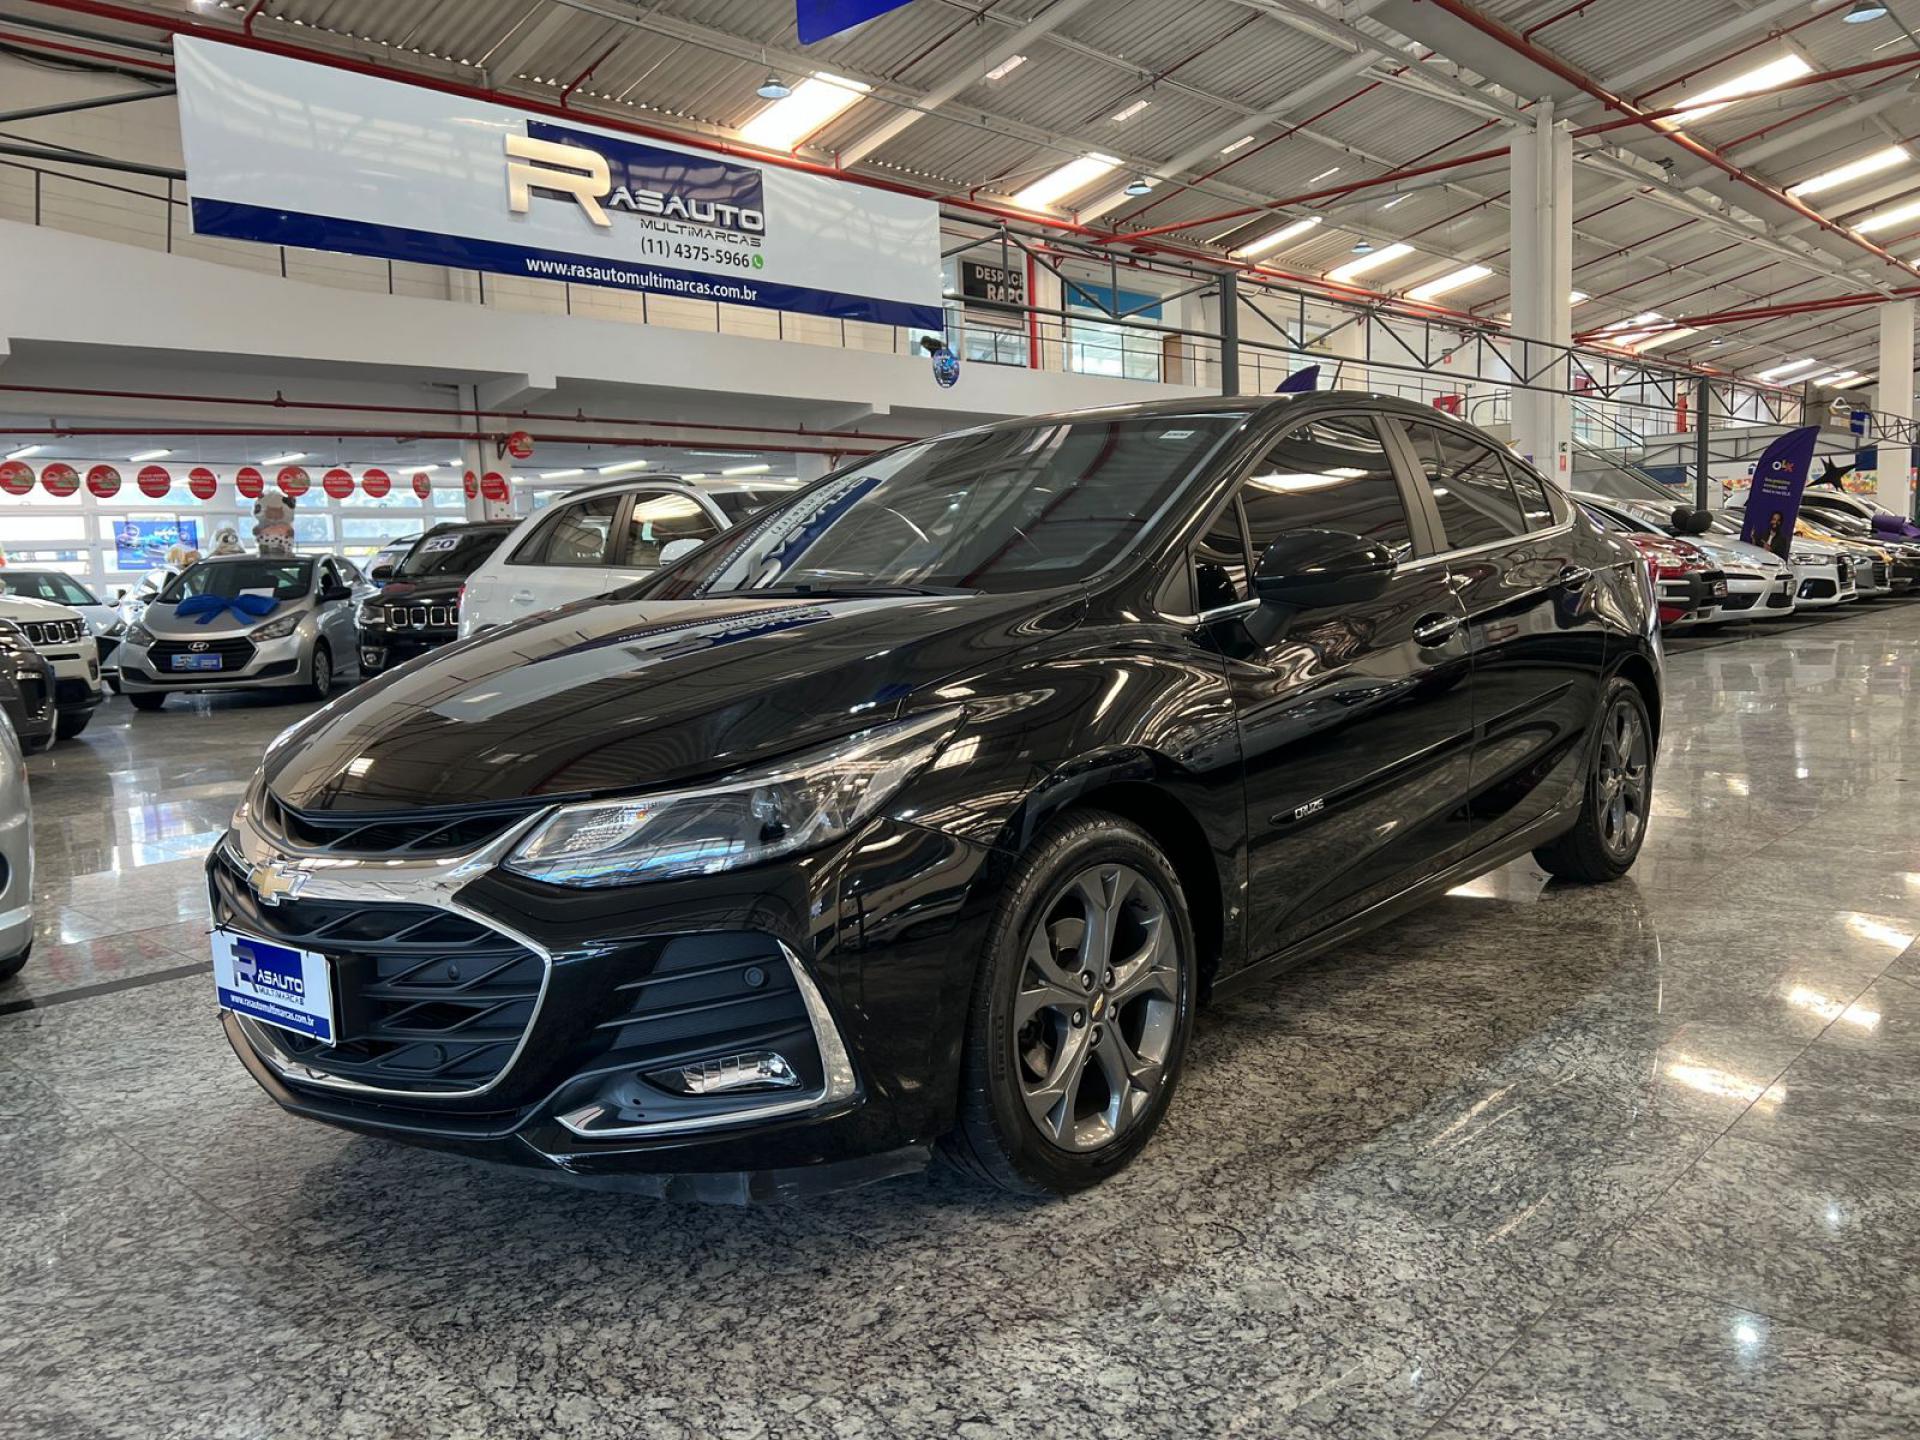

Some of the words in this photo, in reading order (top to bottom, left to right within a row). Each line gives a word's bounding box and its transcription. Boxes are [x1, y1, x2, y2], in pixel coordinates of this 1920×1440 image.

[641, 236, 671, 258] (11)
[674, 243, 750, 268] 4375-5966
[526, 258, 757, 301] www.rasautomultimarcas.com.br
